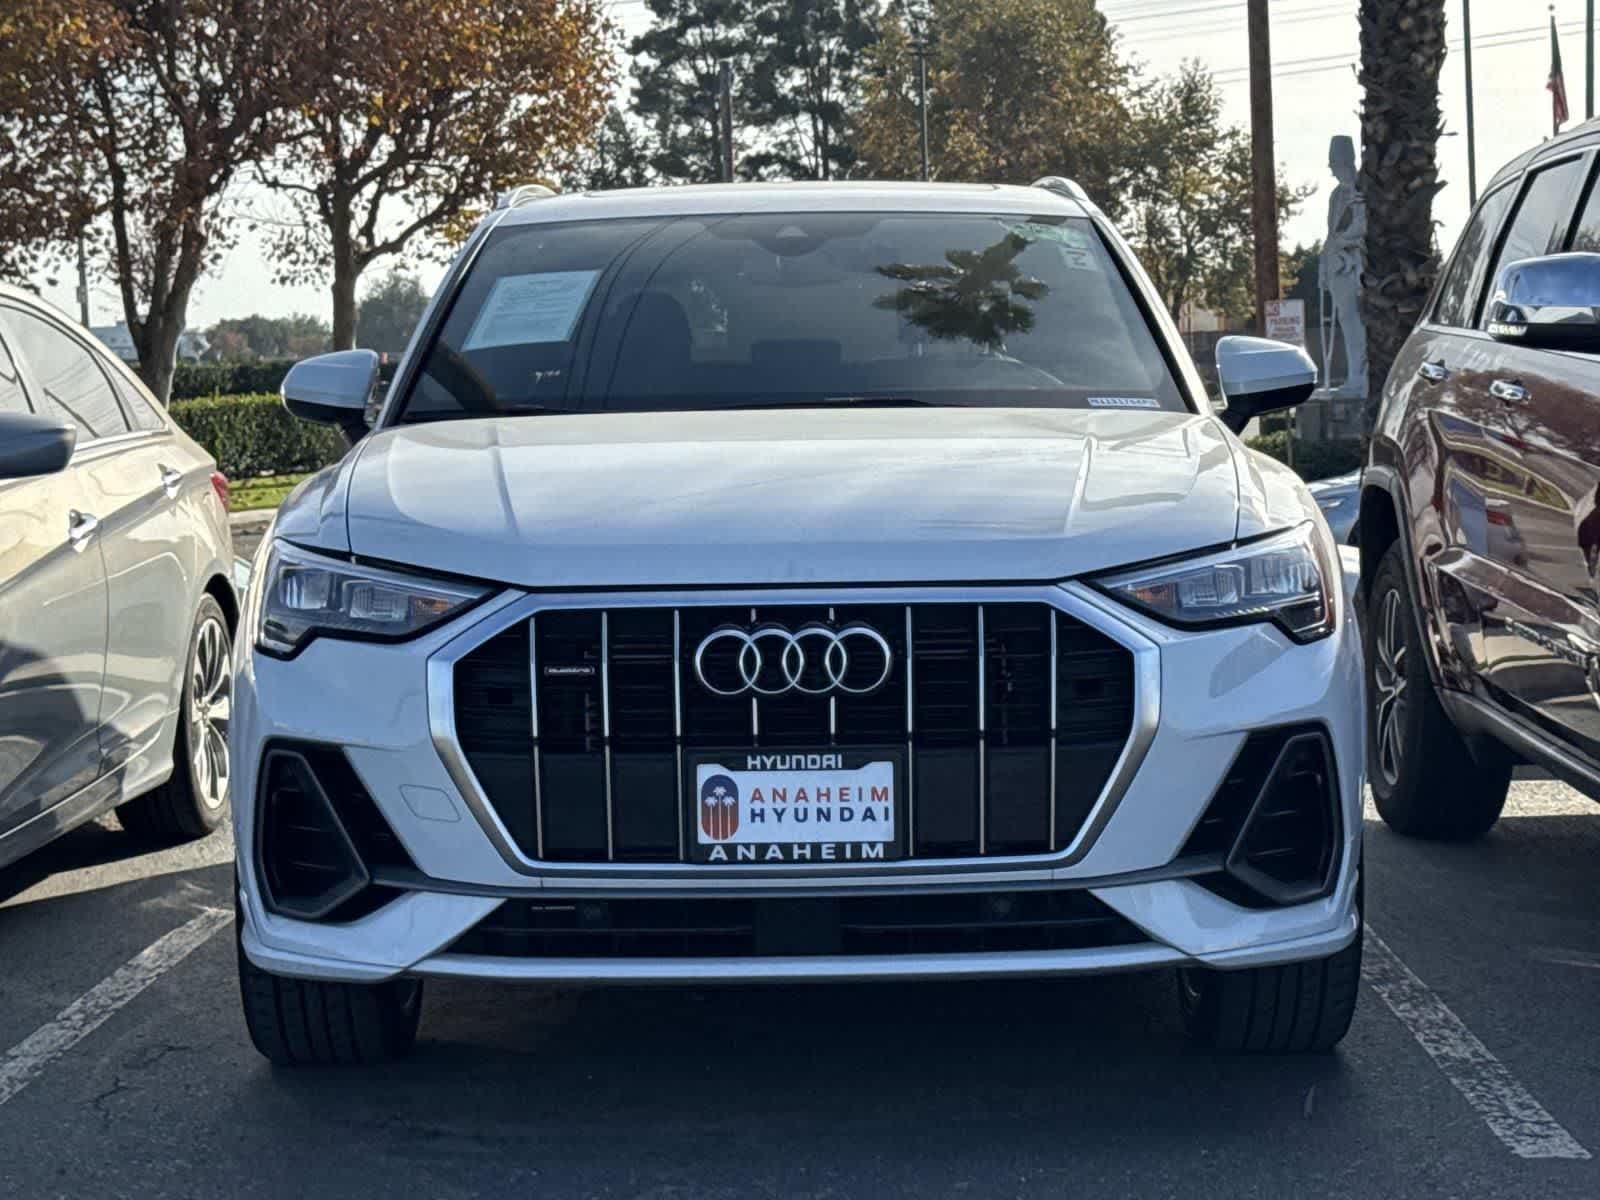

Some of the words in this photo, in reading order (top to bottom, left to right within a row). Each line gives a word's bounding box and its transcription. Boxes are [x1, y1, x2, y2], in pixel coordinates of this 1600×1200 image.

[747, 754, 842, 770] HYUNDAI
[750, 786, 889, 804] ANAHEIM
[750, 806, 890, 824] HYUNDAI
[708, 843, 884, 861] ANAHEIM
